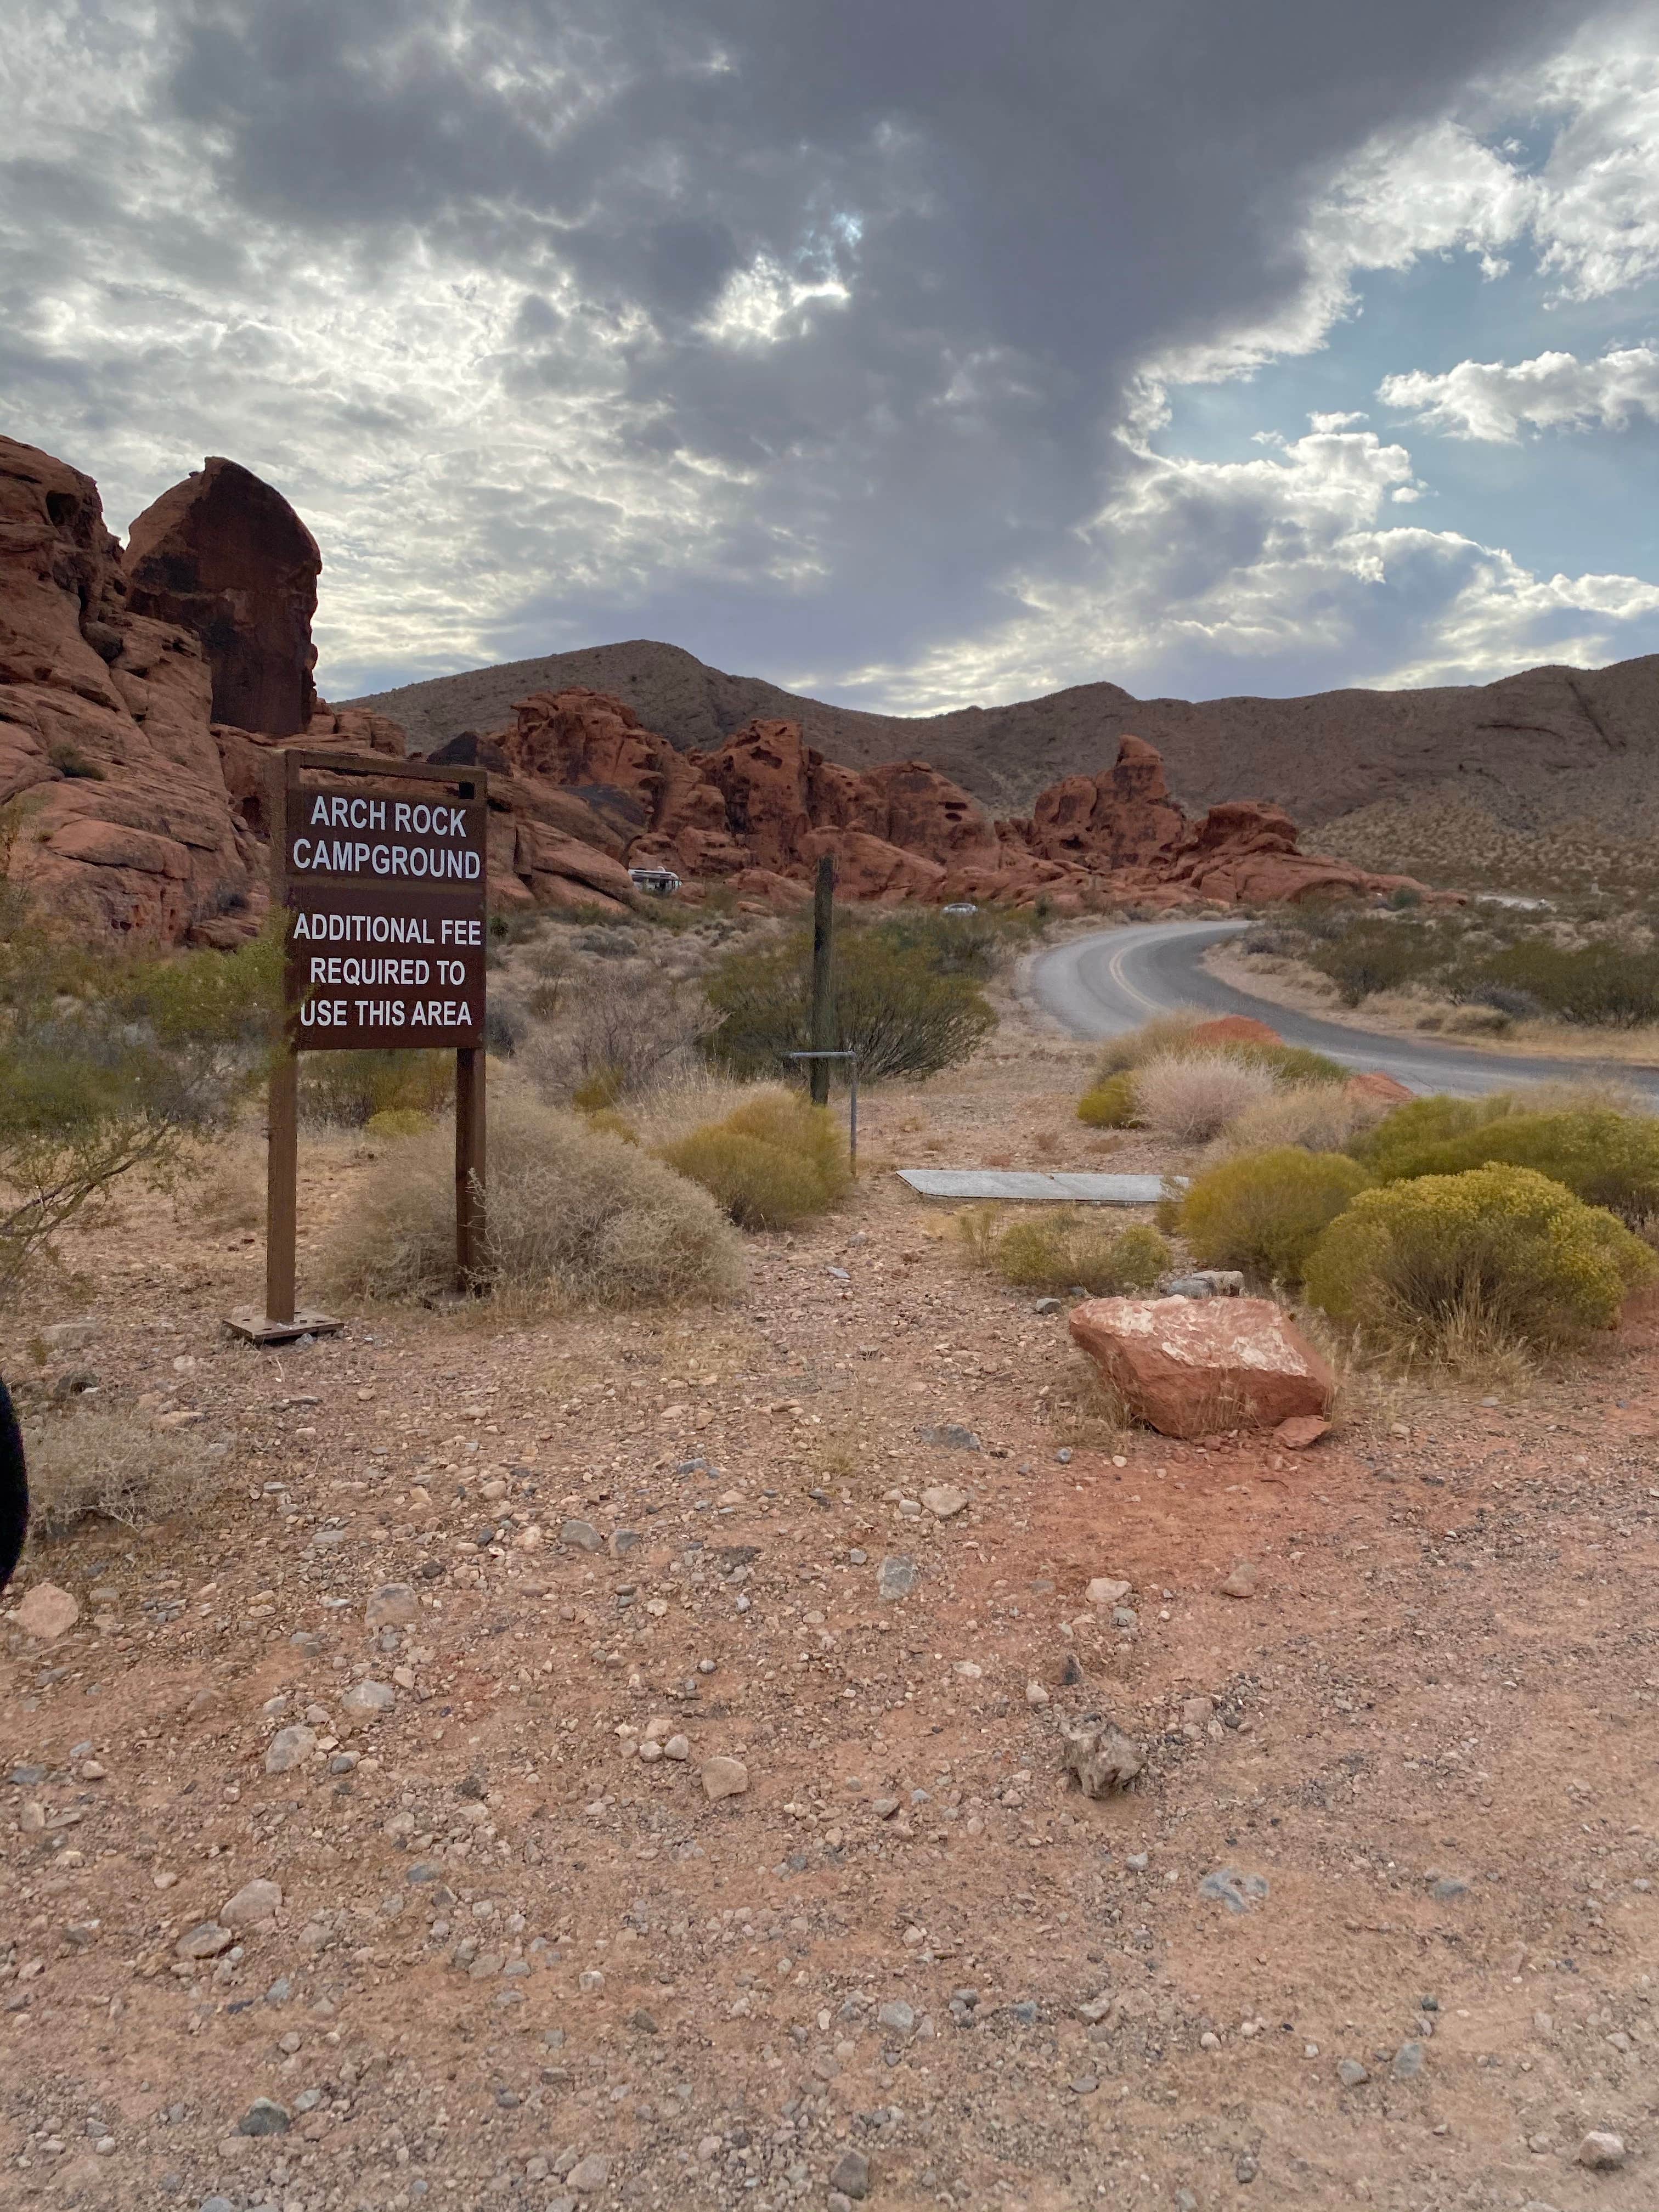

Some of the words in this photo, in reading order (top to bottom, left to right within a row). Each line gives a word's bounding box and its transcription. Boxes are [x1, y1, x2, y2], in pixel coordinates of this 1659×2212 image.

[311, 796, 385, 830] ARCH
[395, 803, 467, 837] ROCK
[293, 839, 481, 879] CAMPGROUND
[293, 913, 435, 944] ADDITIONAL
[442, 920, 482, 945] FEE
[311, 957, 430, 986] REQUIRED
[437, 960, 465, 985] TO
[300, 1001, 347, 1026] USE
[355, 1001, 405, 1026] THIS
[411, 1001, 472, 1025] AREA
